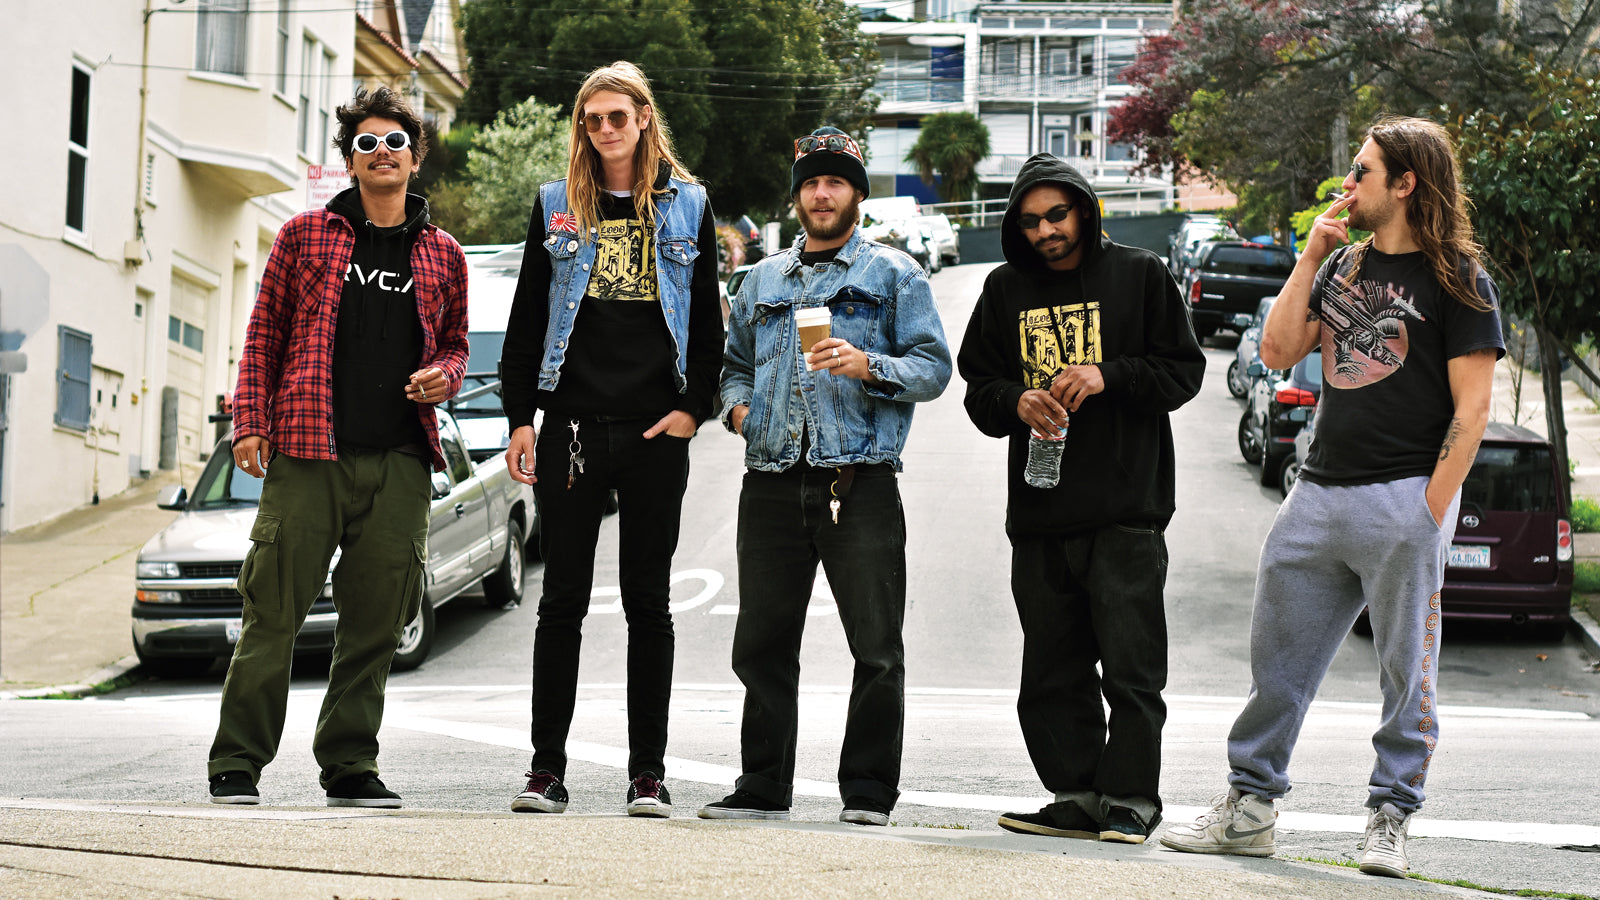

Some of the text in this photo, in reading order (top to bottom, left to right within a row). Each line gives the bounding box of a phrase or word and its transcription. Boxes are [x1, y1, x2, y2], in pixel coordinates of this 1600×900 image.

[309, 167, 321, 178] NO
[601, 225, 626, 234] LOOD
[1451, 553, 1487, 564] 6AJD617
